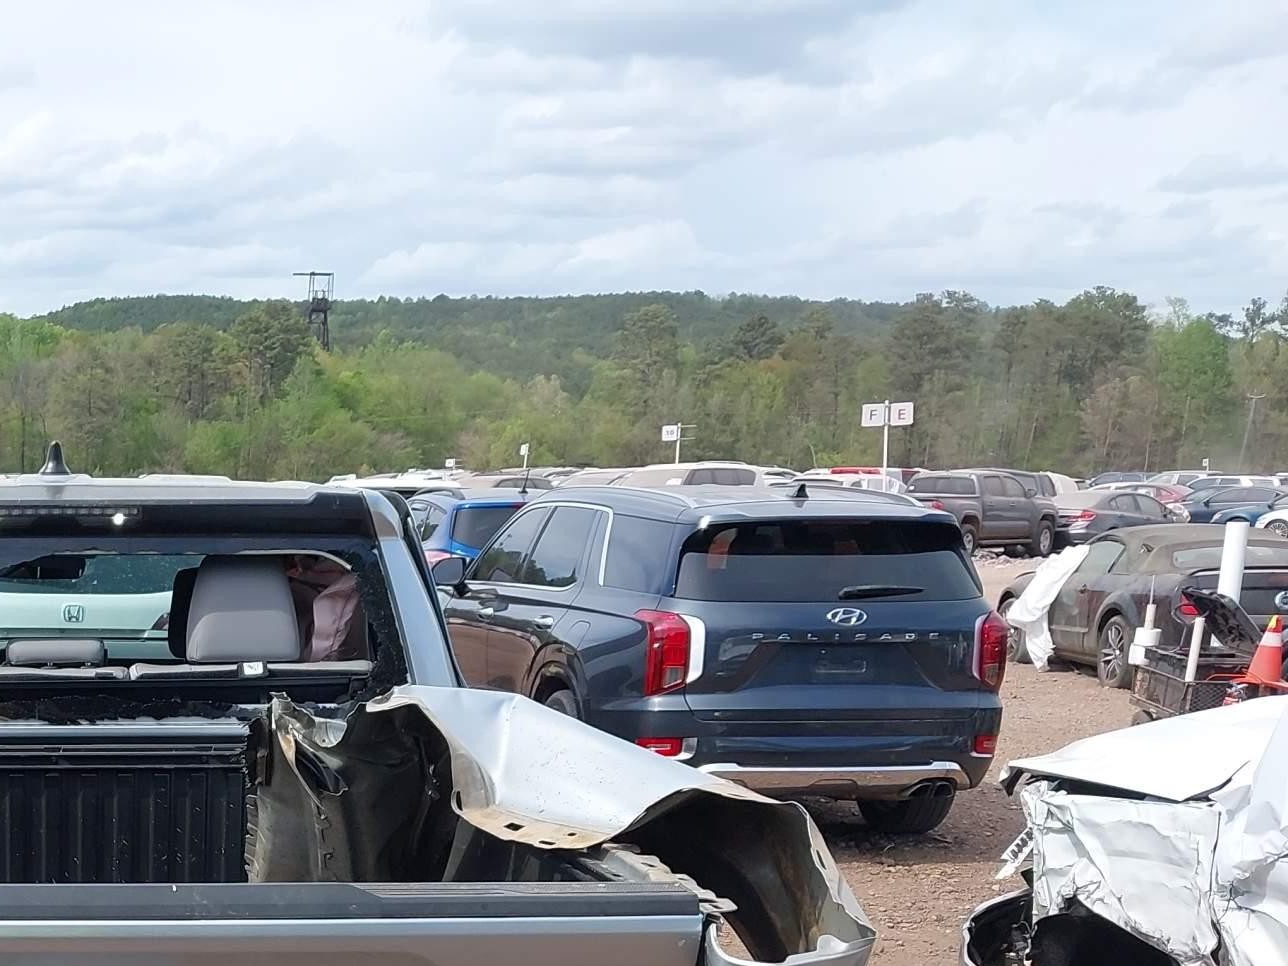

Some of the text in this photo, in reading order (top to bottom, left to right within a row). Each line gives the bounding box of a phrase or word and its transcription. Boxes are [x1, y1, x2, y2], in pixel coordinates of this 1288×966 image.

[869, 409, 878, 421] F
[897, 408, 907, 420] E
[751, 631, 941, 641] PALISADE
